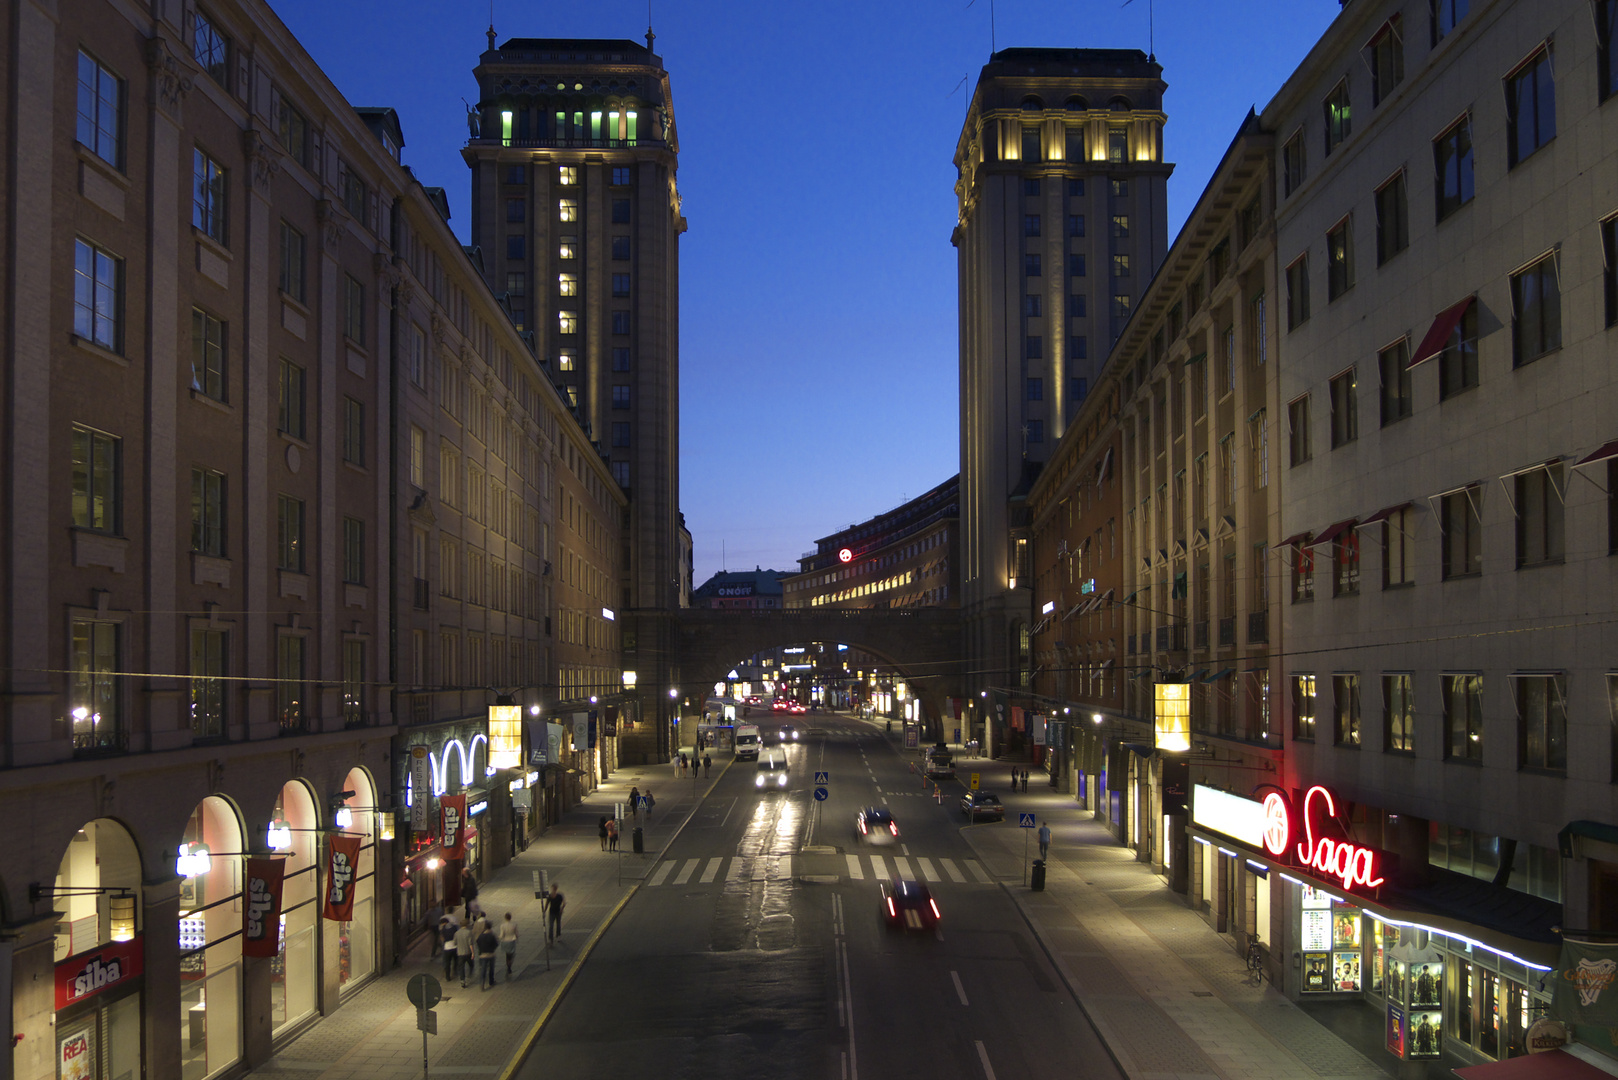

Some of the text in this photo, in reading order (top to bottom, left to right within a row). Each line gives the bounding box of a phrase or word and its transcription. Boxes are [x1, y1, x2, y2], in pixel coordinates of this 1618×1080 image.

[443, 806, 460, 847] siba
[1296, 785, 1385, 890] Saga
[330, 851, 352, 904] siba
[247, 877, 272, 939] siba
[73, 958, 122, 998] siba
[63, 1037, 87, 1062] REA
